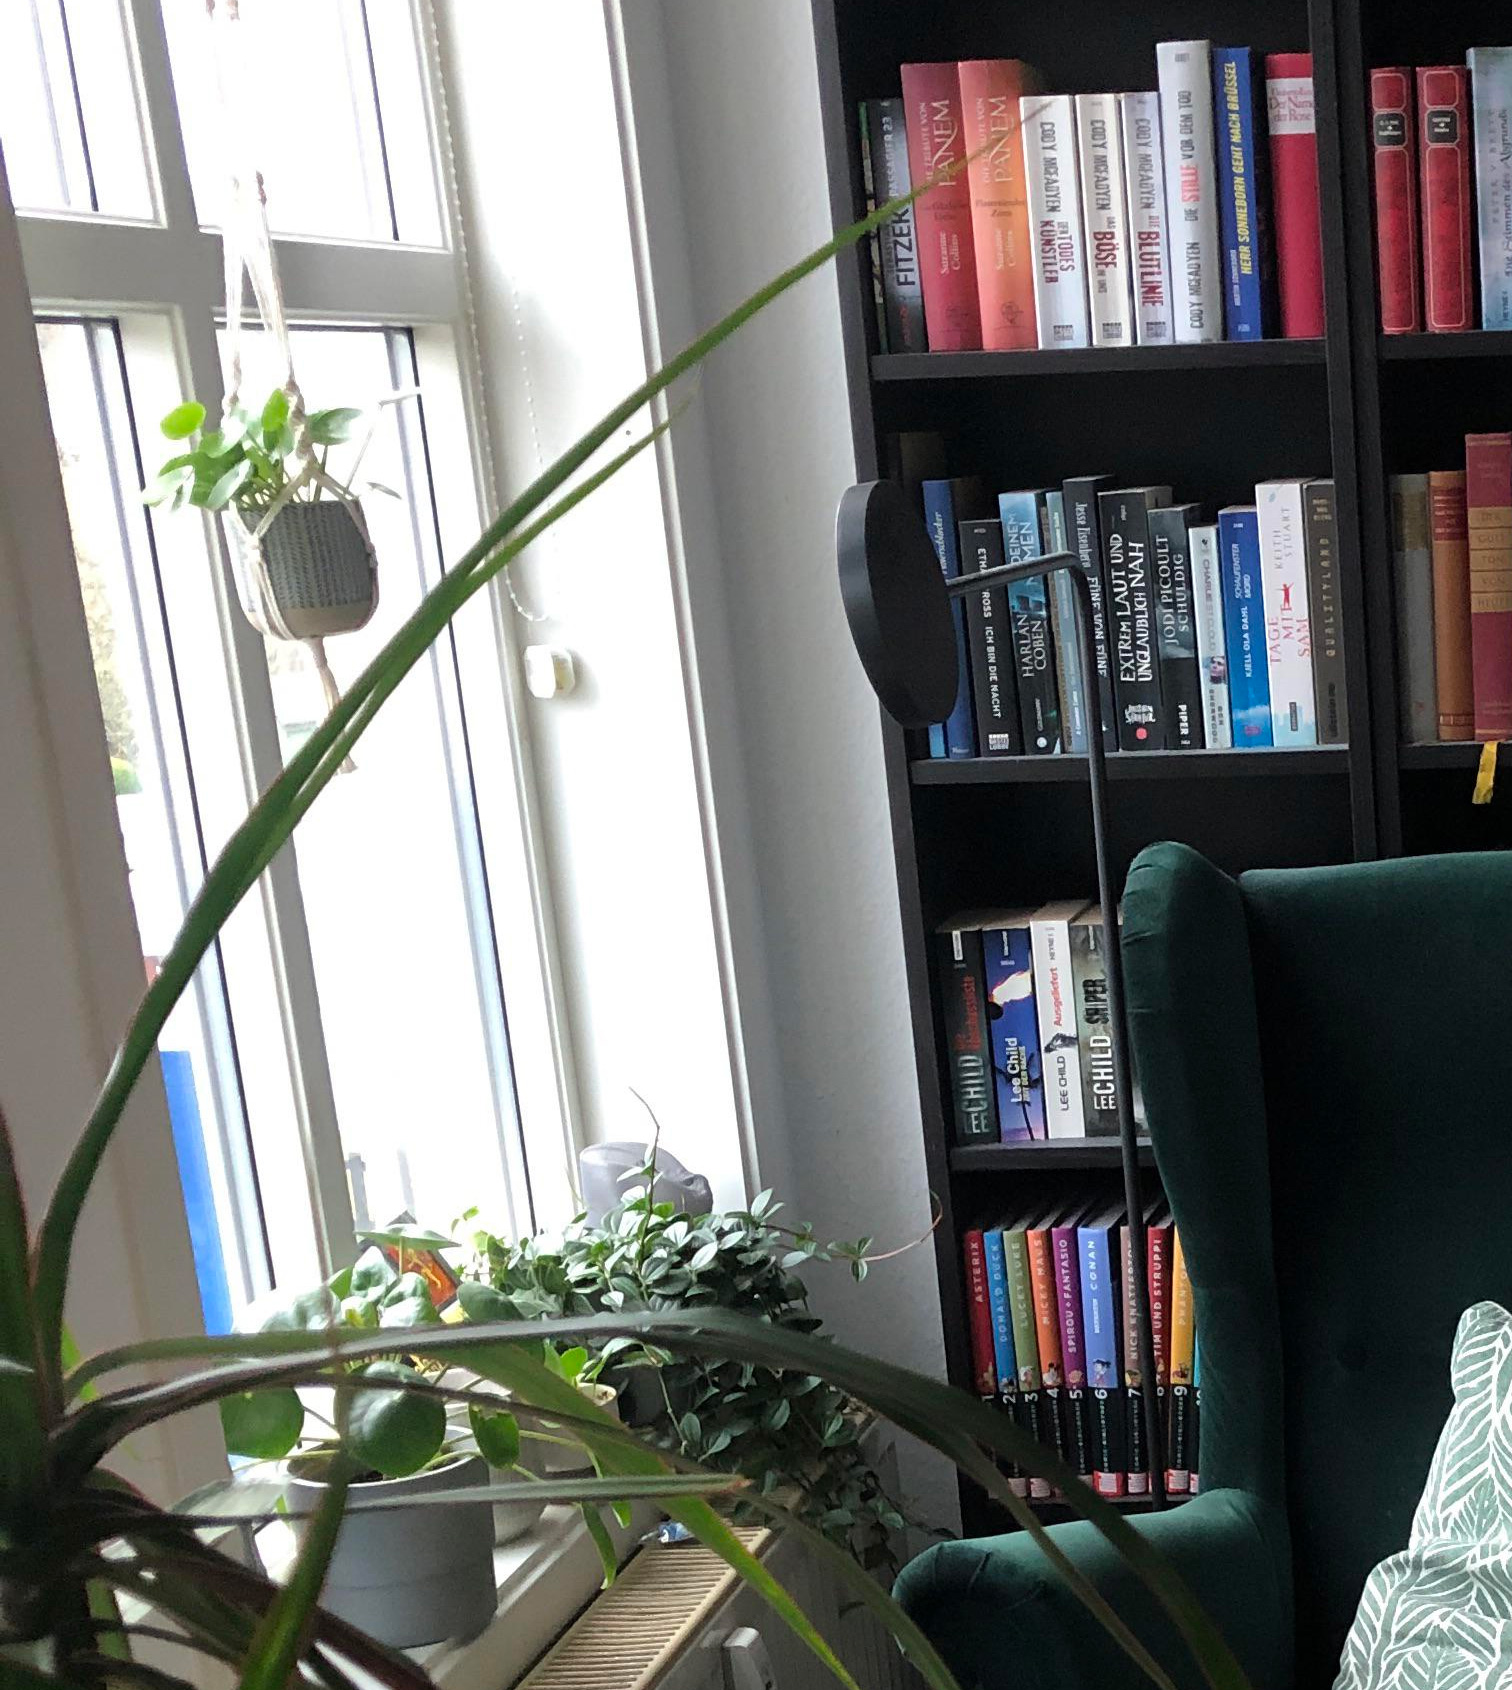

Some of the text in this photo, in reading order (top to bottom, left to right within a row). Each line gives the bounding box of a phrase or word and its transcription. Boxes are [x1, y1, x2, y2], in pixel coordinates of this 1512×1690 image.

[932, 99, 958, 186] PANEM
[989, 95, 1014, 183] PANEM
[1040, 121, 1062, 213] CODY MCFADYEN
[1090, 119, 1111, 211] CODY MCFADYEN
[1135, 118, 1156, 211] CODY MCFADYEN
[1223, 61, 1252, 275] HERR SONNEBORN GEHT NACH BRÜSSEL
[1178, 90, 1204, 329] CODY MCFADYEN DIE STILLE VOR DEM TOD
[891, 208, 916, 287] FITZEK
[1058, 235, 1076, 272] TODES
[1093, 231, 1118, 270] BÖSE
[1137, 231, 1164, 307] BLUTLINIE
[1007, 511, 1021, 563] DEINEM
[1075, 502, 1092, 569] Jesse Eisenberg
[1273, 529, 1283, 569] KEITH
[1281, 506, 1293, 559] STUART
[1156, 535, 1179, 645] JODI PICOULT
[1173, 553, 1189, 632] SCHULDIG
[1202, 558, 1213, 602] CHARLIE
[1231, 543, 1242, 599] SCHAUFENSTER
[1319, 537, 1336, 657] QUALITYLAND
[977, 548, 1001, 718] ETHA ROSS ICH BIN DIE NACHT
[1110, 534, 1135, 681] EXTREM LAUT UND
[1128, 541, 1152, 681] UNGLAUBLICH NAH
[1279, 605, 1294, 639] MIT
[1296, 618, 1310, 657] SAM
[1016, 614, 1035, 678] HARLAN
[1031, 620, 1047, 670] COBEN
[1241, 606, 1252, 677] KJELL OLA DAHL
[1267, 617, 1282, 664] TAGE
[1179, 705, 1189, 734] PIPER
[1082, 978, 1110, 1025] SNIPER
[1005, 1038, 1022, 1103] Lee Child
[1049, 967, 1069, 1111] LEE CHILD Ausgeliefert
[1090, 1035, 1114, 1093] CHILD
[958, 1055, 988, 1113] CHILD
[970, 1241, 984, 1303] ASTERIX
[990, 1244, 1009, 1343] DONALD DUCK
[1012, 1241, 1029, 1328] LUCKY LUKE
[1033, 1238, 1050, 1326] MICKY MAUS
[1059, 1239, 1077, 1354] SPIROU FANTASIO
[1087, 1240, 1098, 1291] CONAN
[1153, 1238, 1163, 1357] TIM UND STRUPPI
[1129, 1328, 1138, 1360] NICK
[1002, 1393, 1017, 1405] 2
[1024, 1392, 1039, 1402] 3
[1046, 1388, 1060, 1400] 4
[1069, 1388, 1083, 1400] 5
[1094, 1388, 1108, 1400] 6
[1128, 1388, 1142, 1399] 7
[1173, 1385, 1188, 1397] 9
